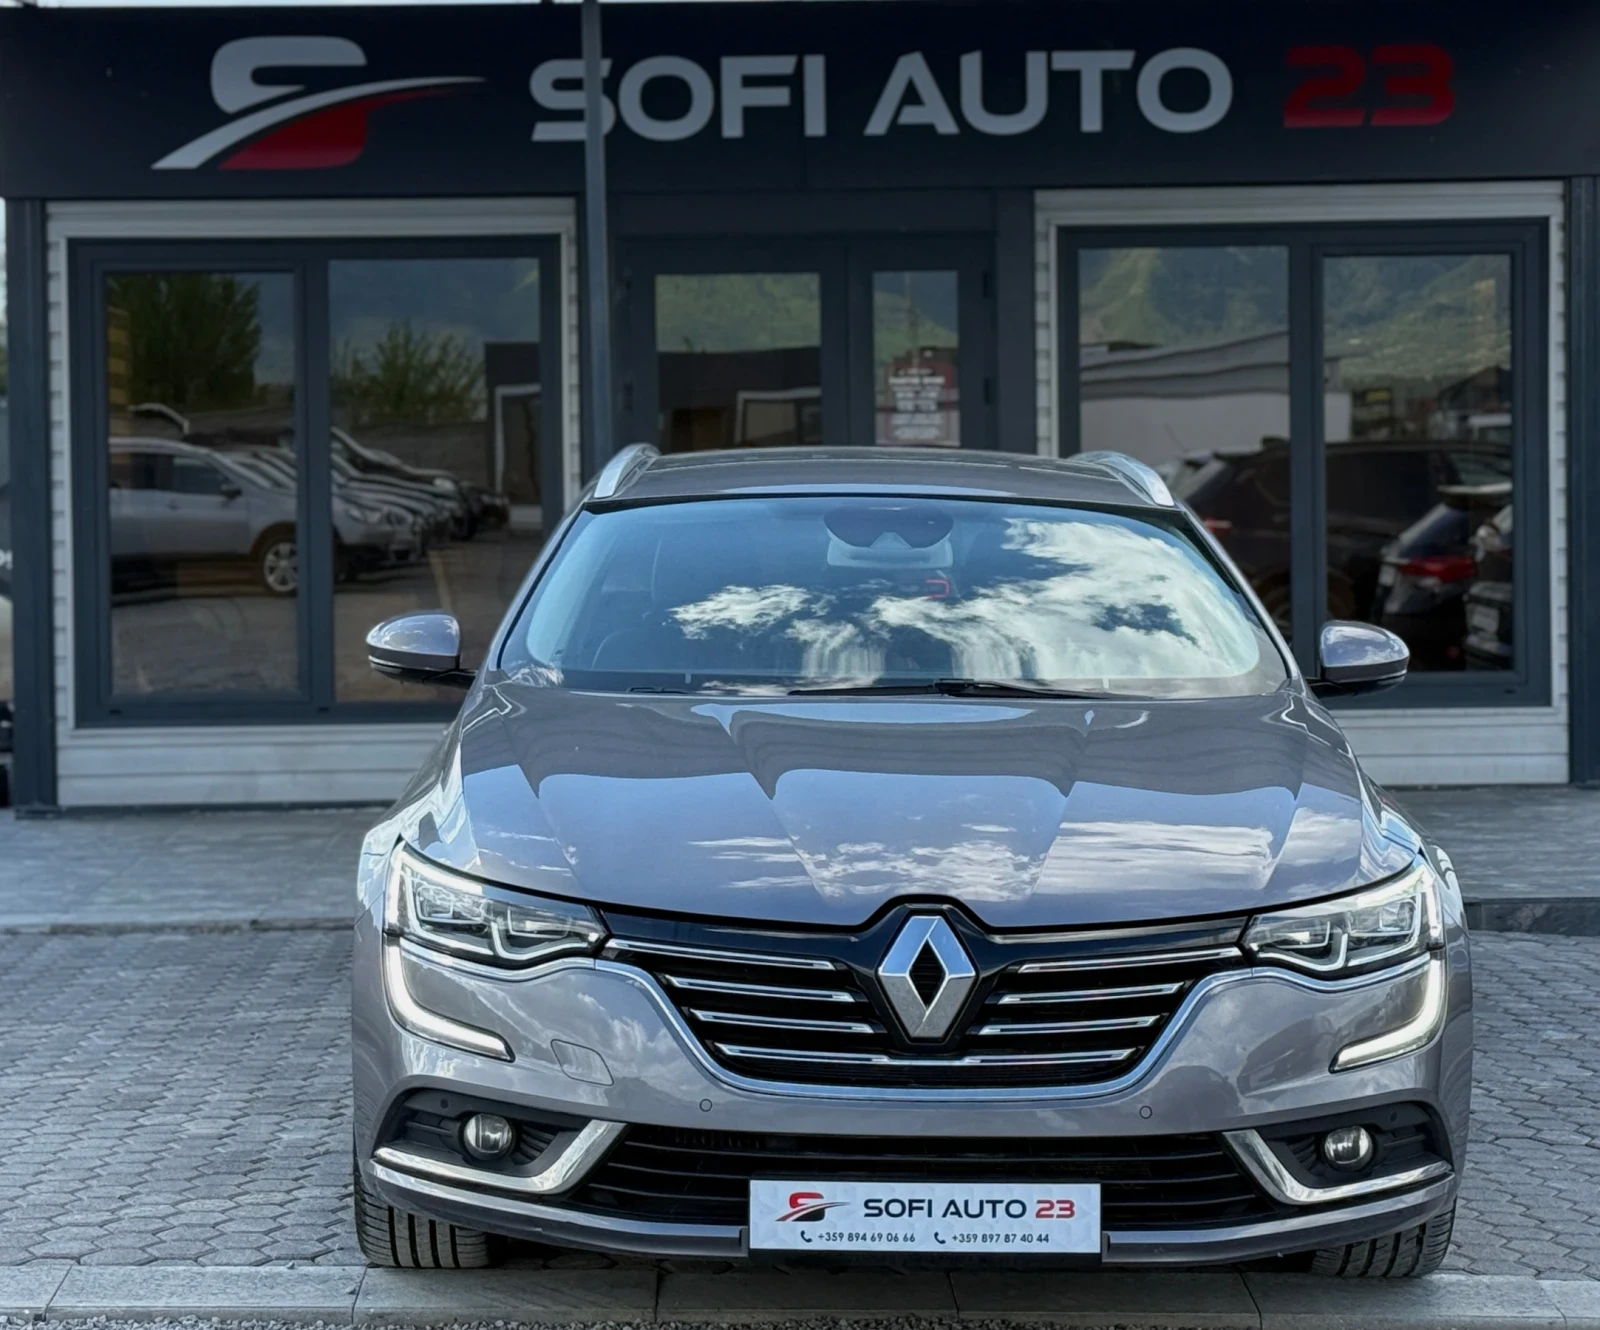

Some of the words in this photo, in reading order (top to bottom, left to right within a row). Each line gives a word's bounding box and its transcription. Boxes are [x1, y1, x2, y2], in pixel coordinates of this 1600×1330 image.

[530, 54, 827, 142] SOFI
[863, 47, 1234, 137] AUTO
[1283, 44, 1456, 128] 23
[863, 1198, 933, 1219] SOFI
[941, 1199, 1027, 1219] AUTO
[1035, 1199, 1076, 1219] 23
[818, 1232, 845, 1243] +359
[847, 1232, 867, 1243] 894
[870, 1232, 883, 1243] 69
[886, 1232, 899, 1243] 06
[902, 1232, 916, 1243] 66
[952, 1233, 978, 1244] +359
[981, 1233, 1001, 1244] 897
[1003, 1233, 1017, 1244] 87
[1020, 1233, 1034, 1244] 40
[1036, 1233, 1050, 1244] 44
